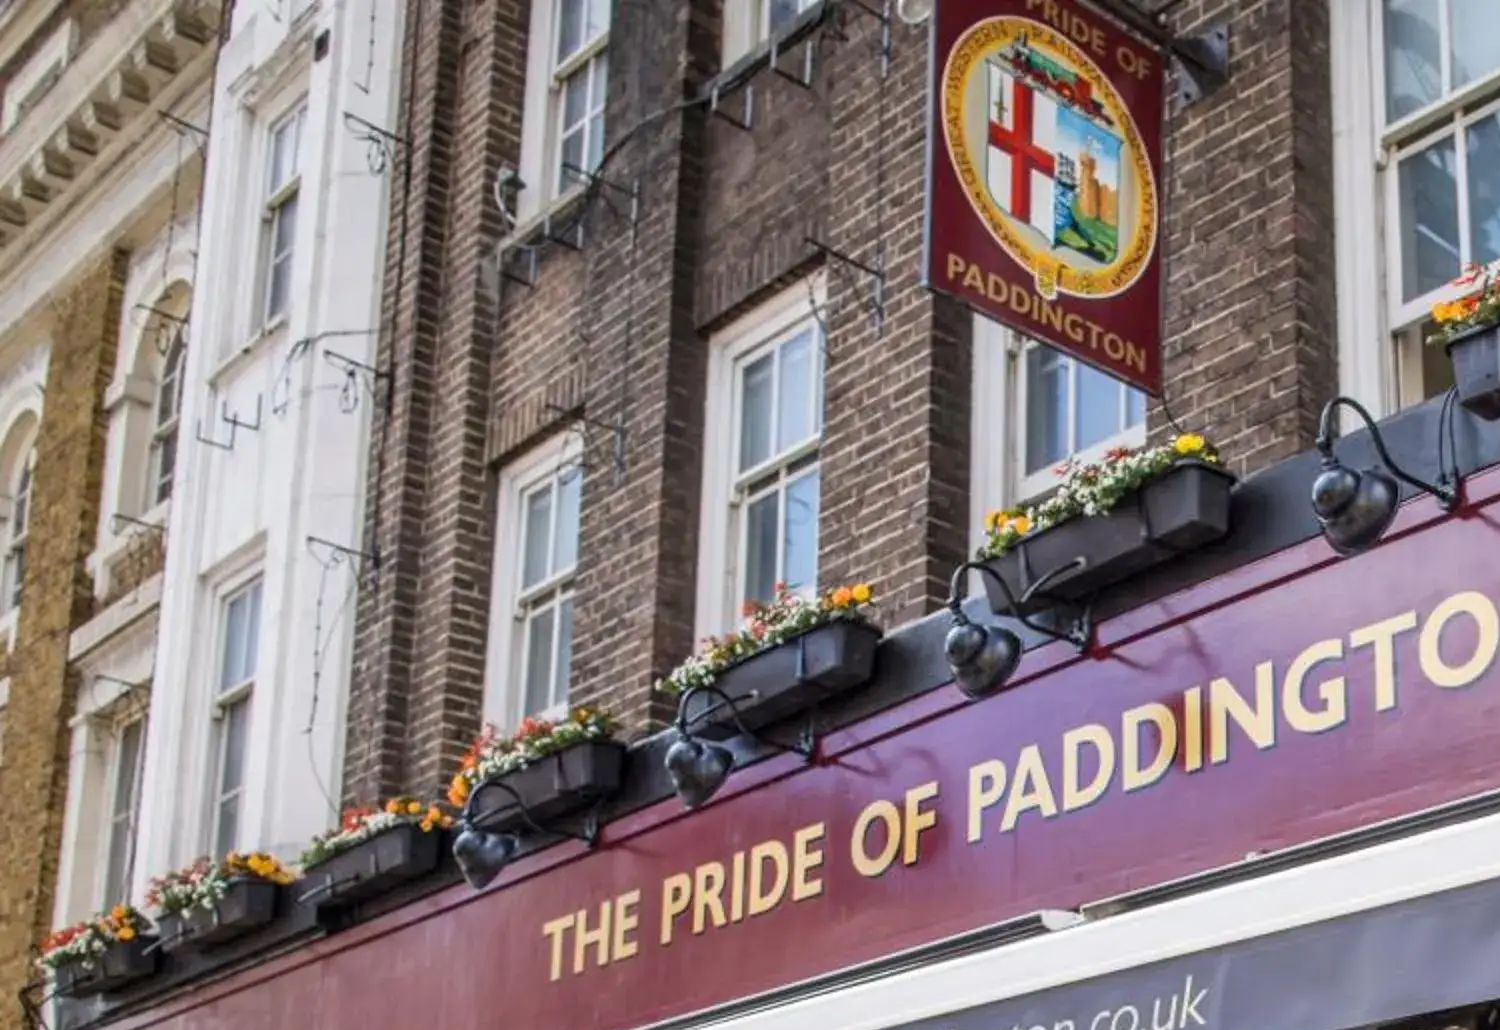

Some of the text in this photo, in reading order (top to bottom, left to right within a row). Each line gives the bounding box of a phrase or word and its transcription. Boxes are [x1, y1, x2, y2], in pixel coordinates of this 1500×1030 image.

[1116, 46, 1153, 80] OF
[945, 252, 1147, 374] PADDINGTON
[543, 889, 641, 982] THE
[660, 822, 825, 946] PRIDE
[851, 781, 939, 878] OF
